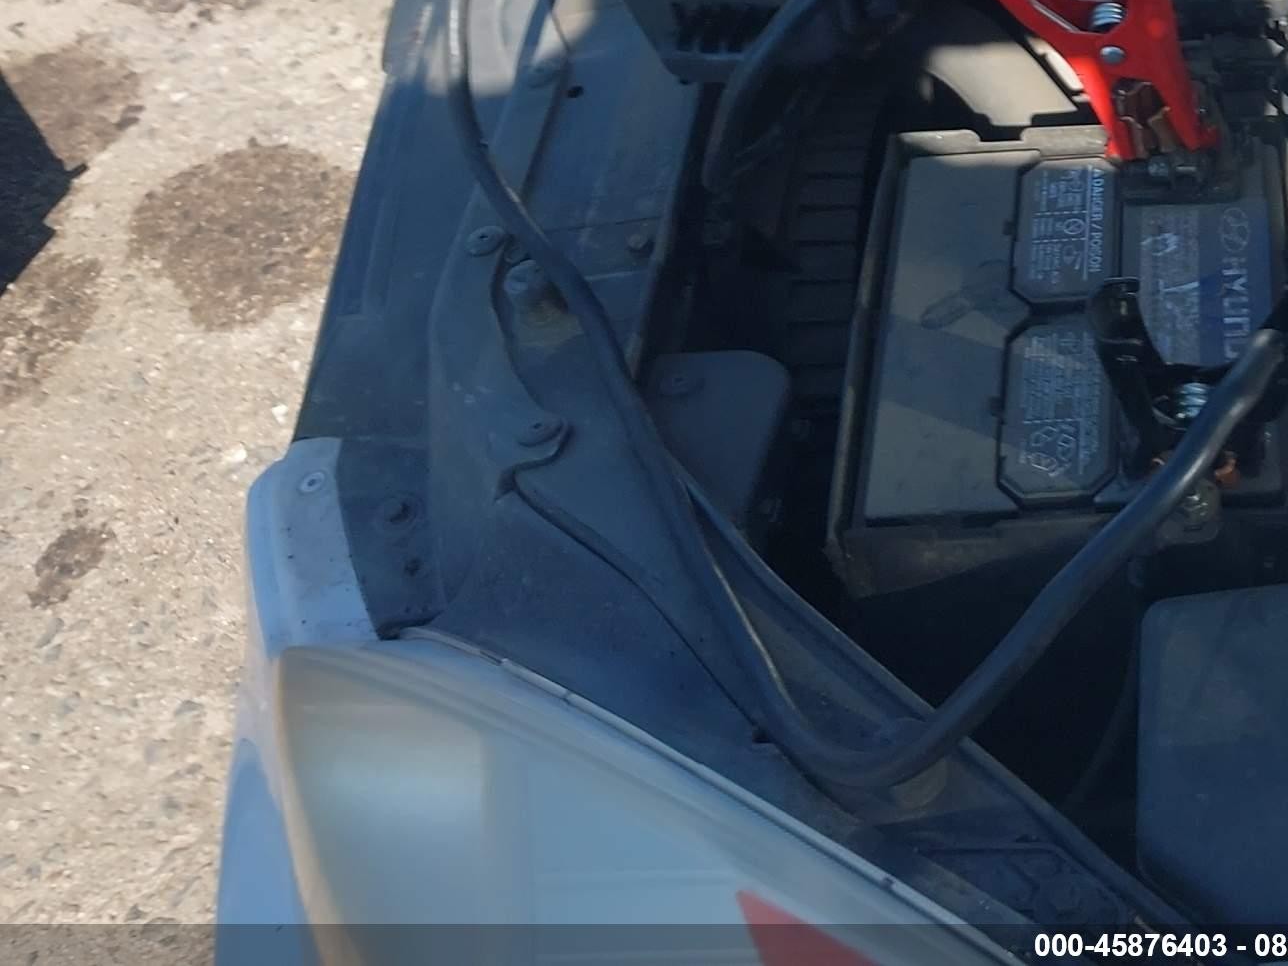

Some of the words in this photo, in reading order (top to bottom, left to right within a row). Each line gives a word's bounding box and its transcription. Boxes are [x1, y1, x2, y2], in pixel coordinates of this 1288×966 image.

[1091, 177, 1104, 221] DANGER
[1088, 231, 1103, 273] POISON
[1222, 255, 1250, 360] HYUND
